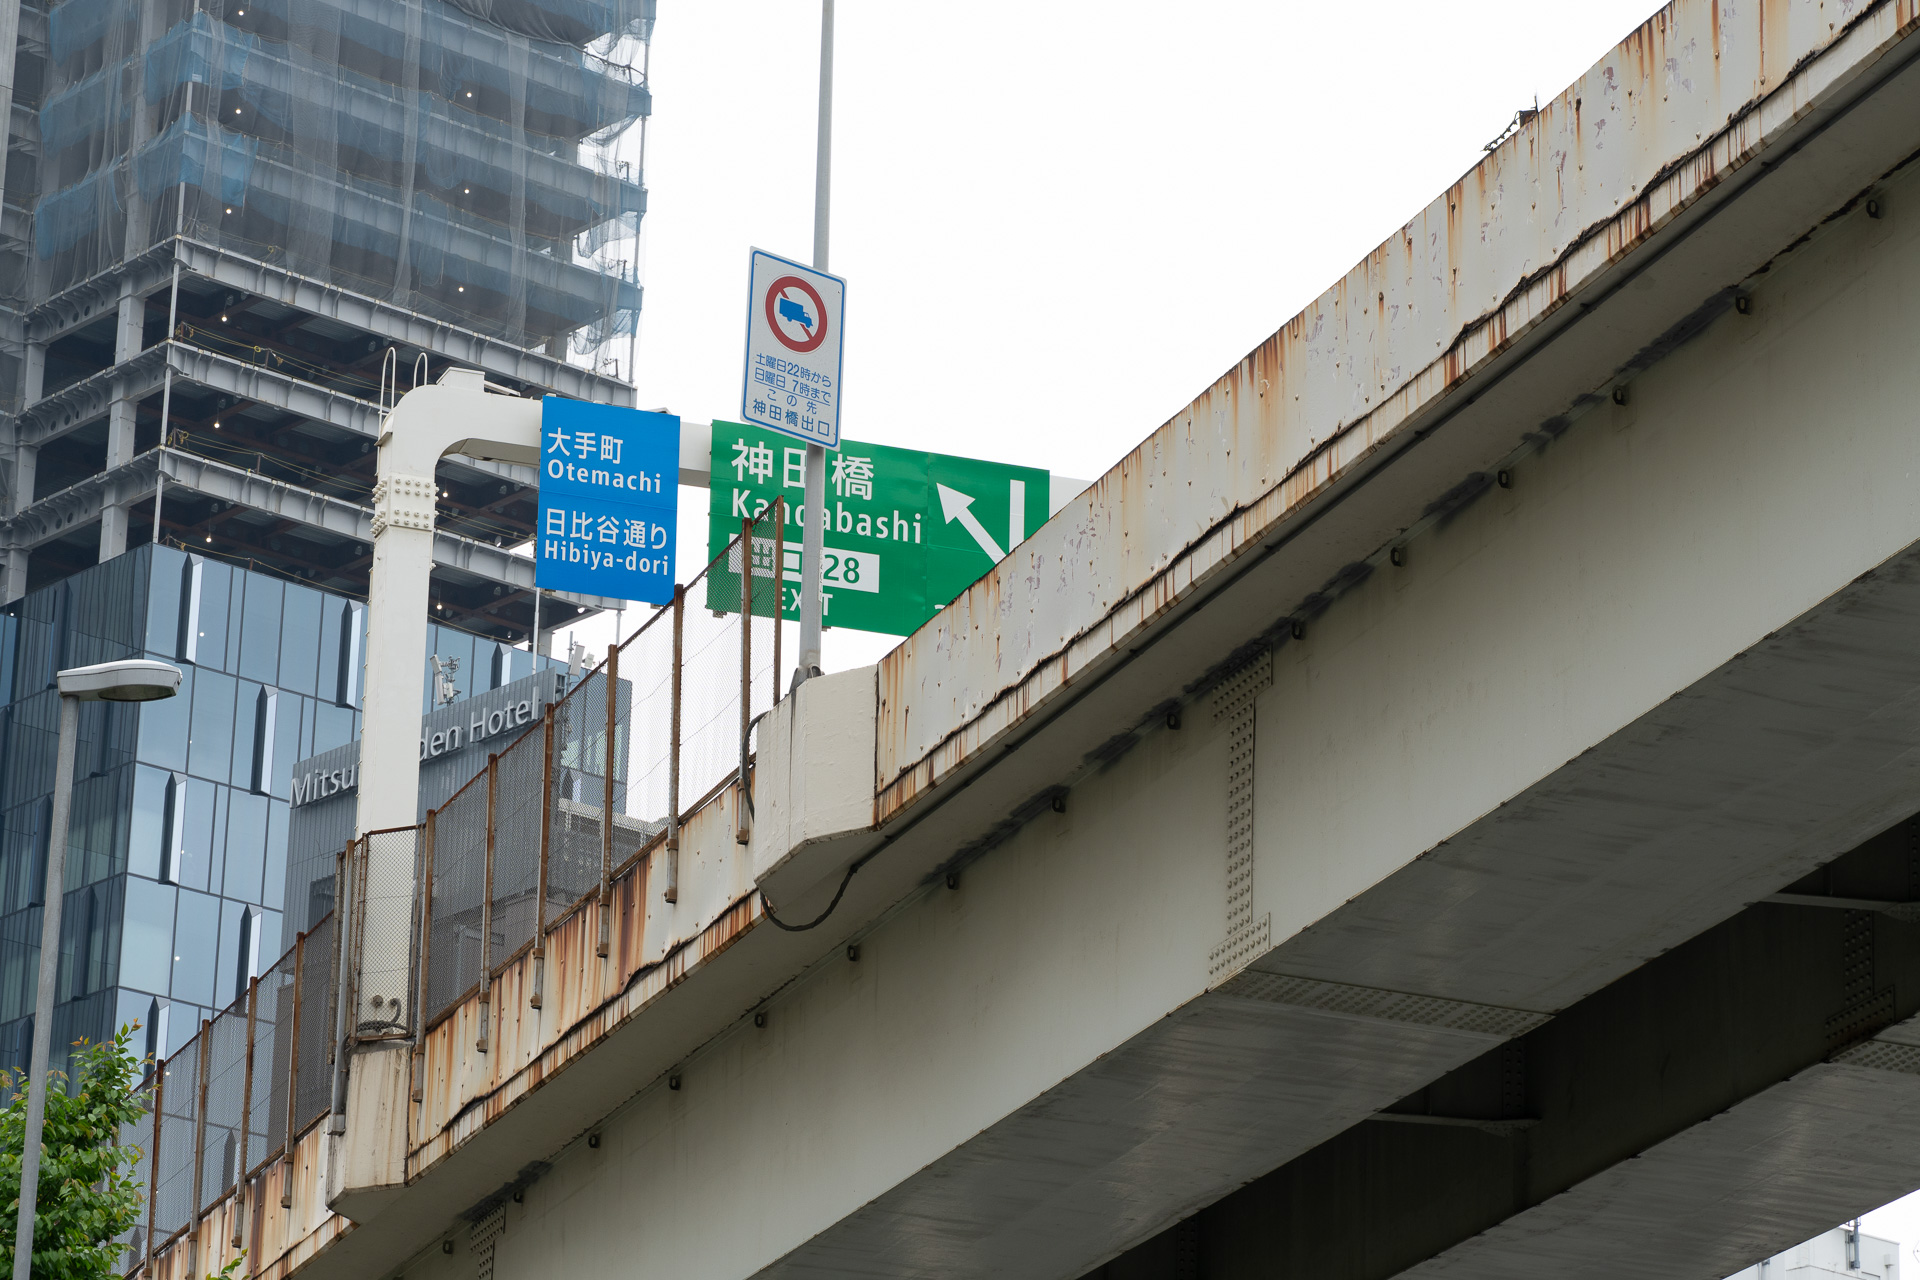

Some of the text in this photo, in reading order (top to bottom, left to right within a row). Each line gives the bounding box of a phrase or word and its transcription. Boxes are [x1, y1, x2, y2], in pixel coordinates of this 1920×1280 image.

[755, 353, 832, 388] 土曜日22時から
[752, 398, 830, 437] 神田橋出口
[767, 388, 818, 415] この先
[547, 427, 624, 465] 大手町
[547, 458, 661, 494] Otemachi
[546, 508, 668, 550] 日比谷通り
[544, 539, 669, 576] Hibiya-dori
[823, 554, 860, 584] 28
[782, 587, 834, 616] EXT
[289, 685, 540, 810] Mitsu den Hotel
